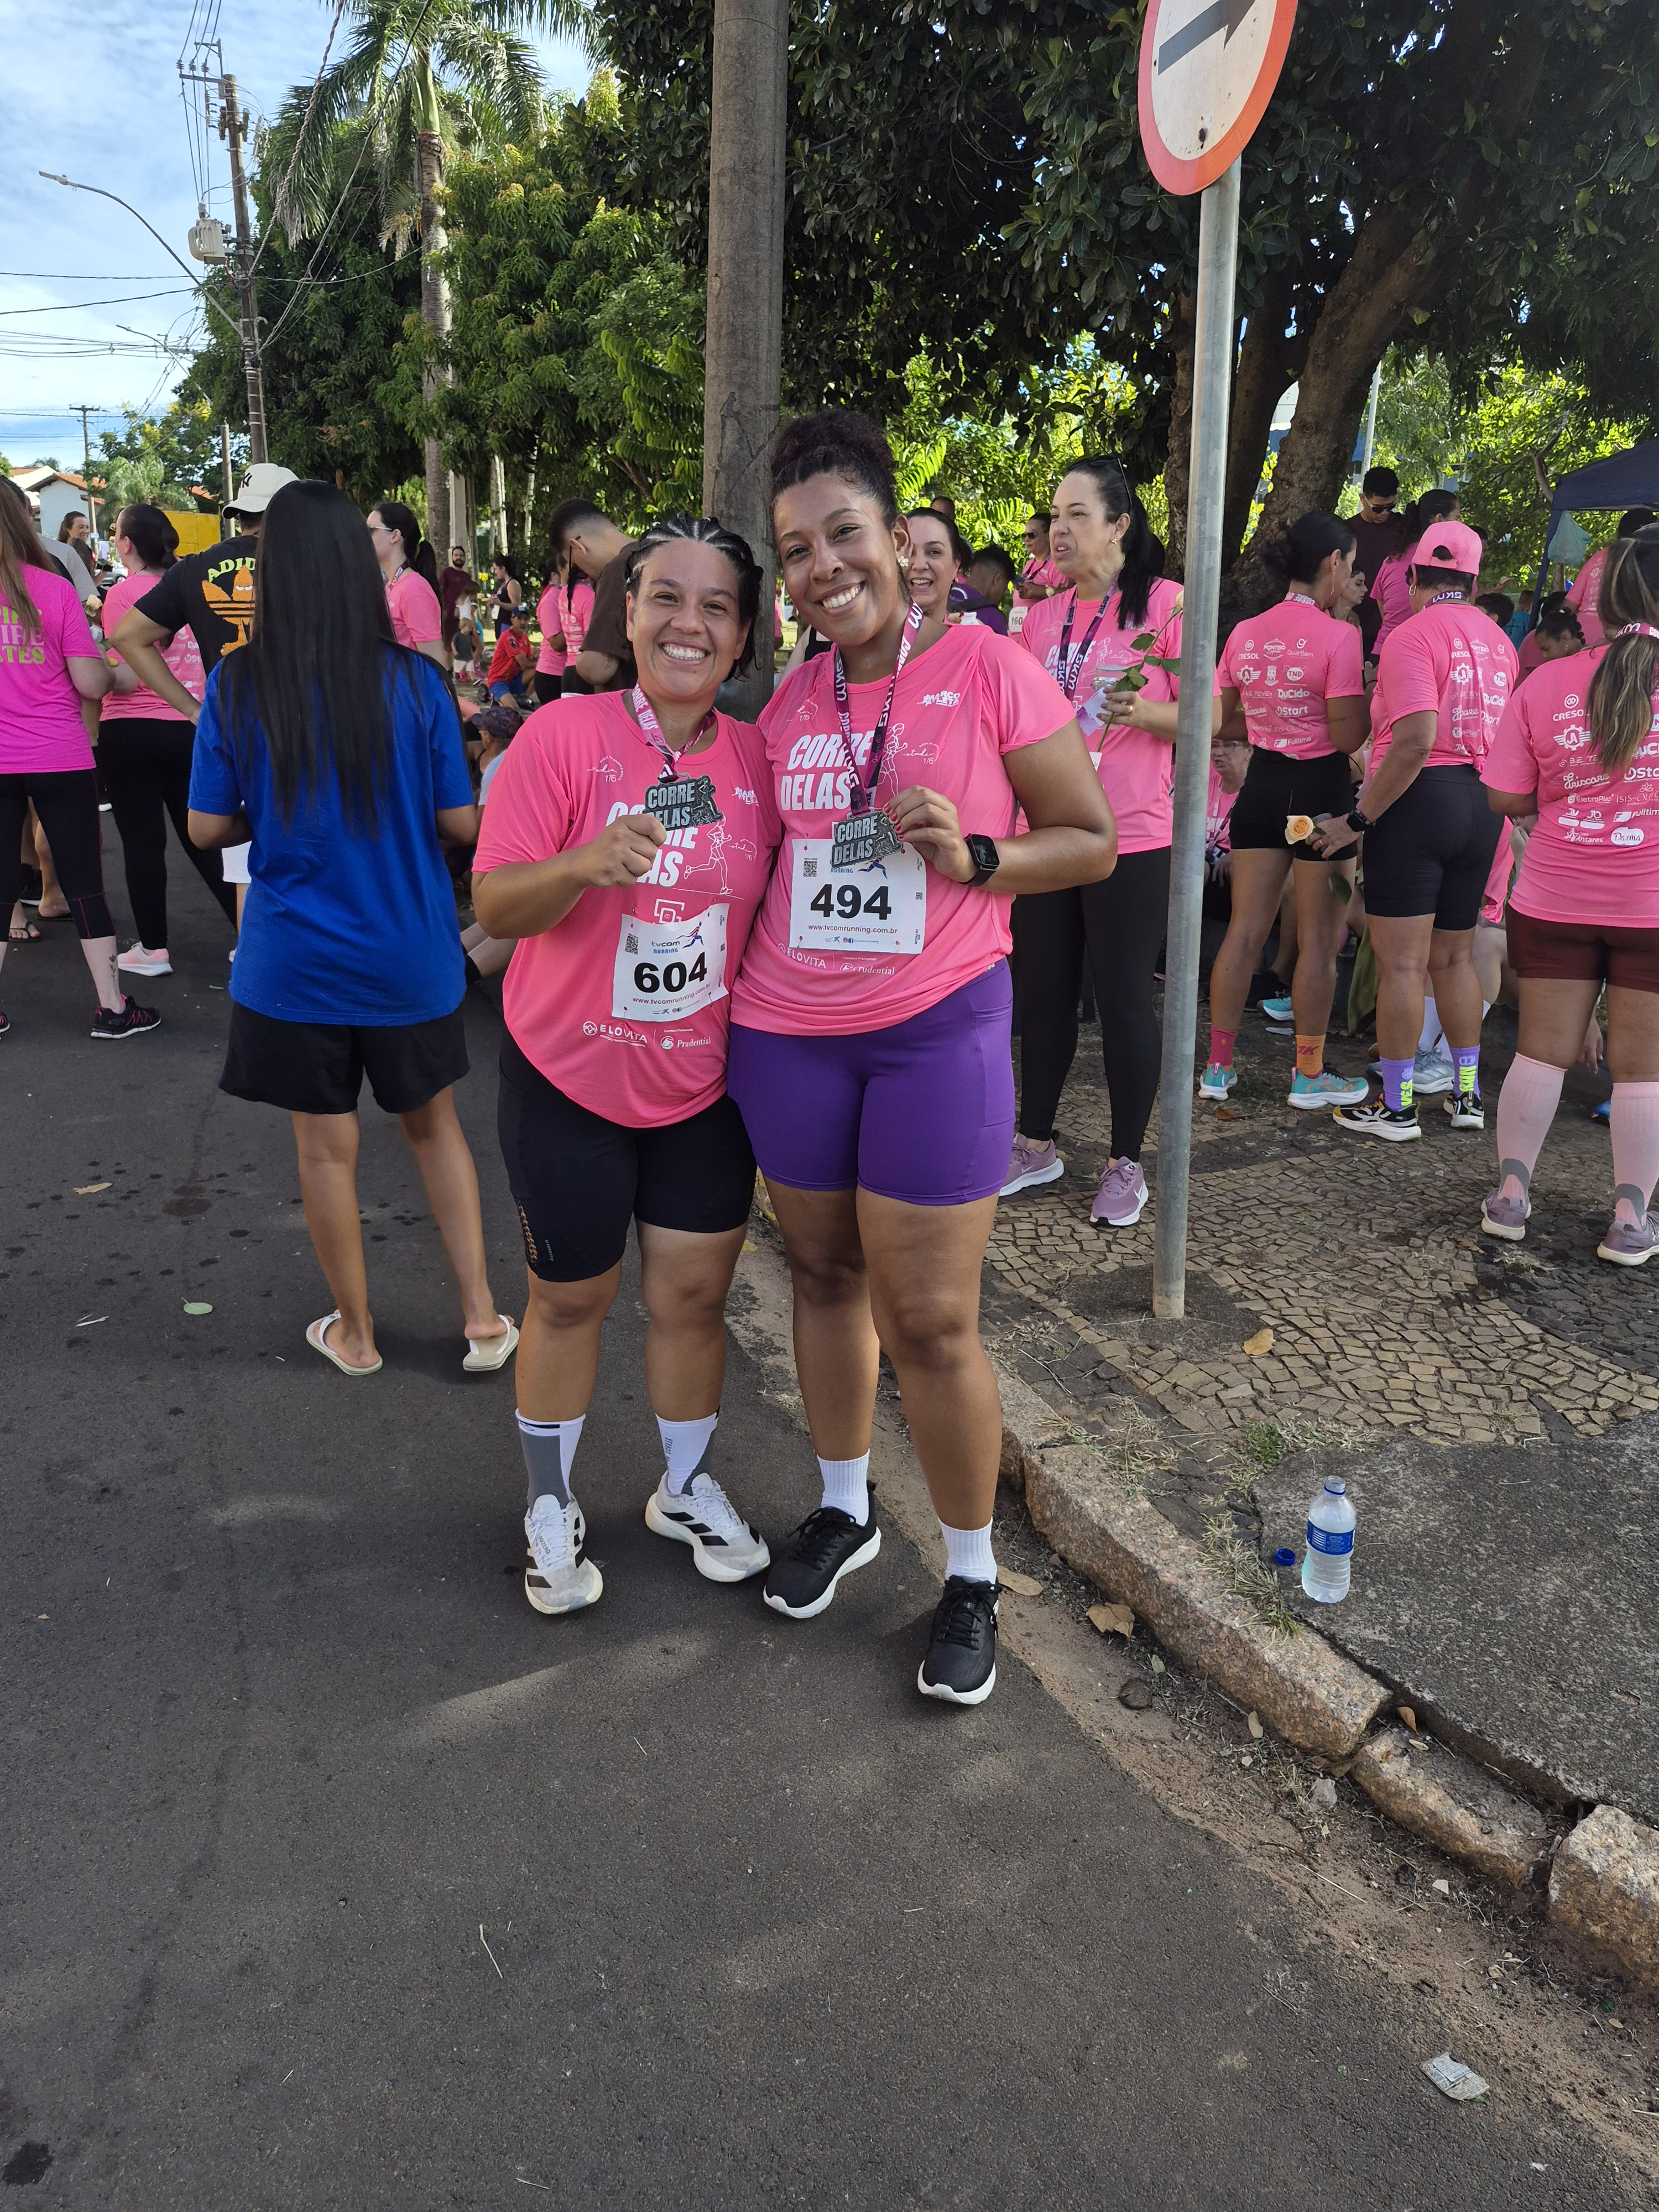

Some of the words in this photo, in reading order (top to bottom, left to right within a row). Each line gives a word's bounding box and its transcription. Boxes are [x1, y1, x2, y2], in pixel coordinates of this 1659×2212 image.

[648, 781, 696, 809] CORRE
[780, 770, 851, 811] DELAS
[648, 806, 691, 828] ELAS
[837, 815, 878, 844] CORRE
[833, 838, 874, 865] DELAS
[810, 884, 892, 921] 494
[808, 924, 898, 935] www.tvcomrunning.com.br
[786, 948, 826, 969] ELOVITA
[634, 951, 708, 994] 604
[632, 983, 711, 1005] www.tvcomrunning.com.br
[599, 1024, 648, 1044] ELOVITA
[676, 1036, 711, 1048] Prudential
[1459, 1065, 1477, 1093] RUN
